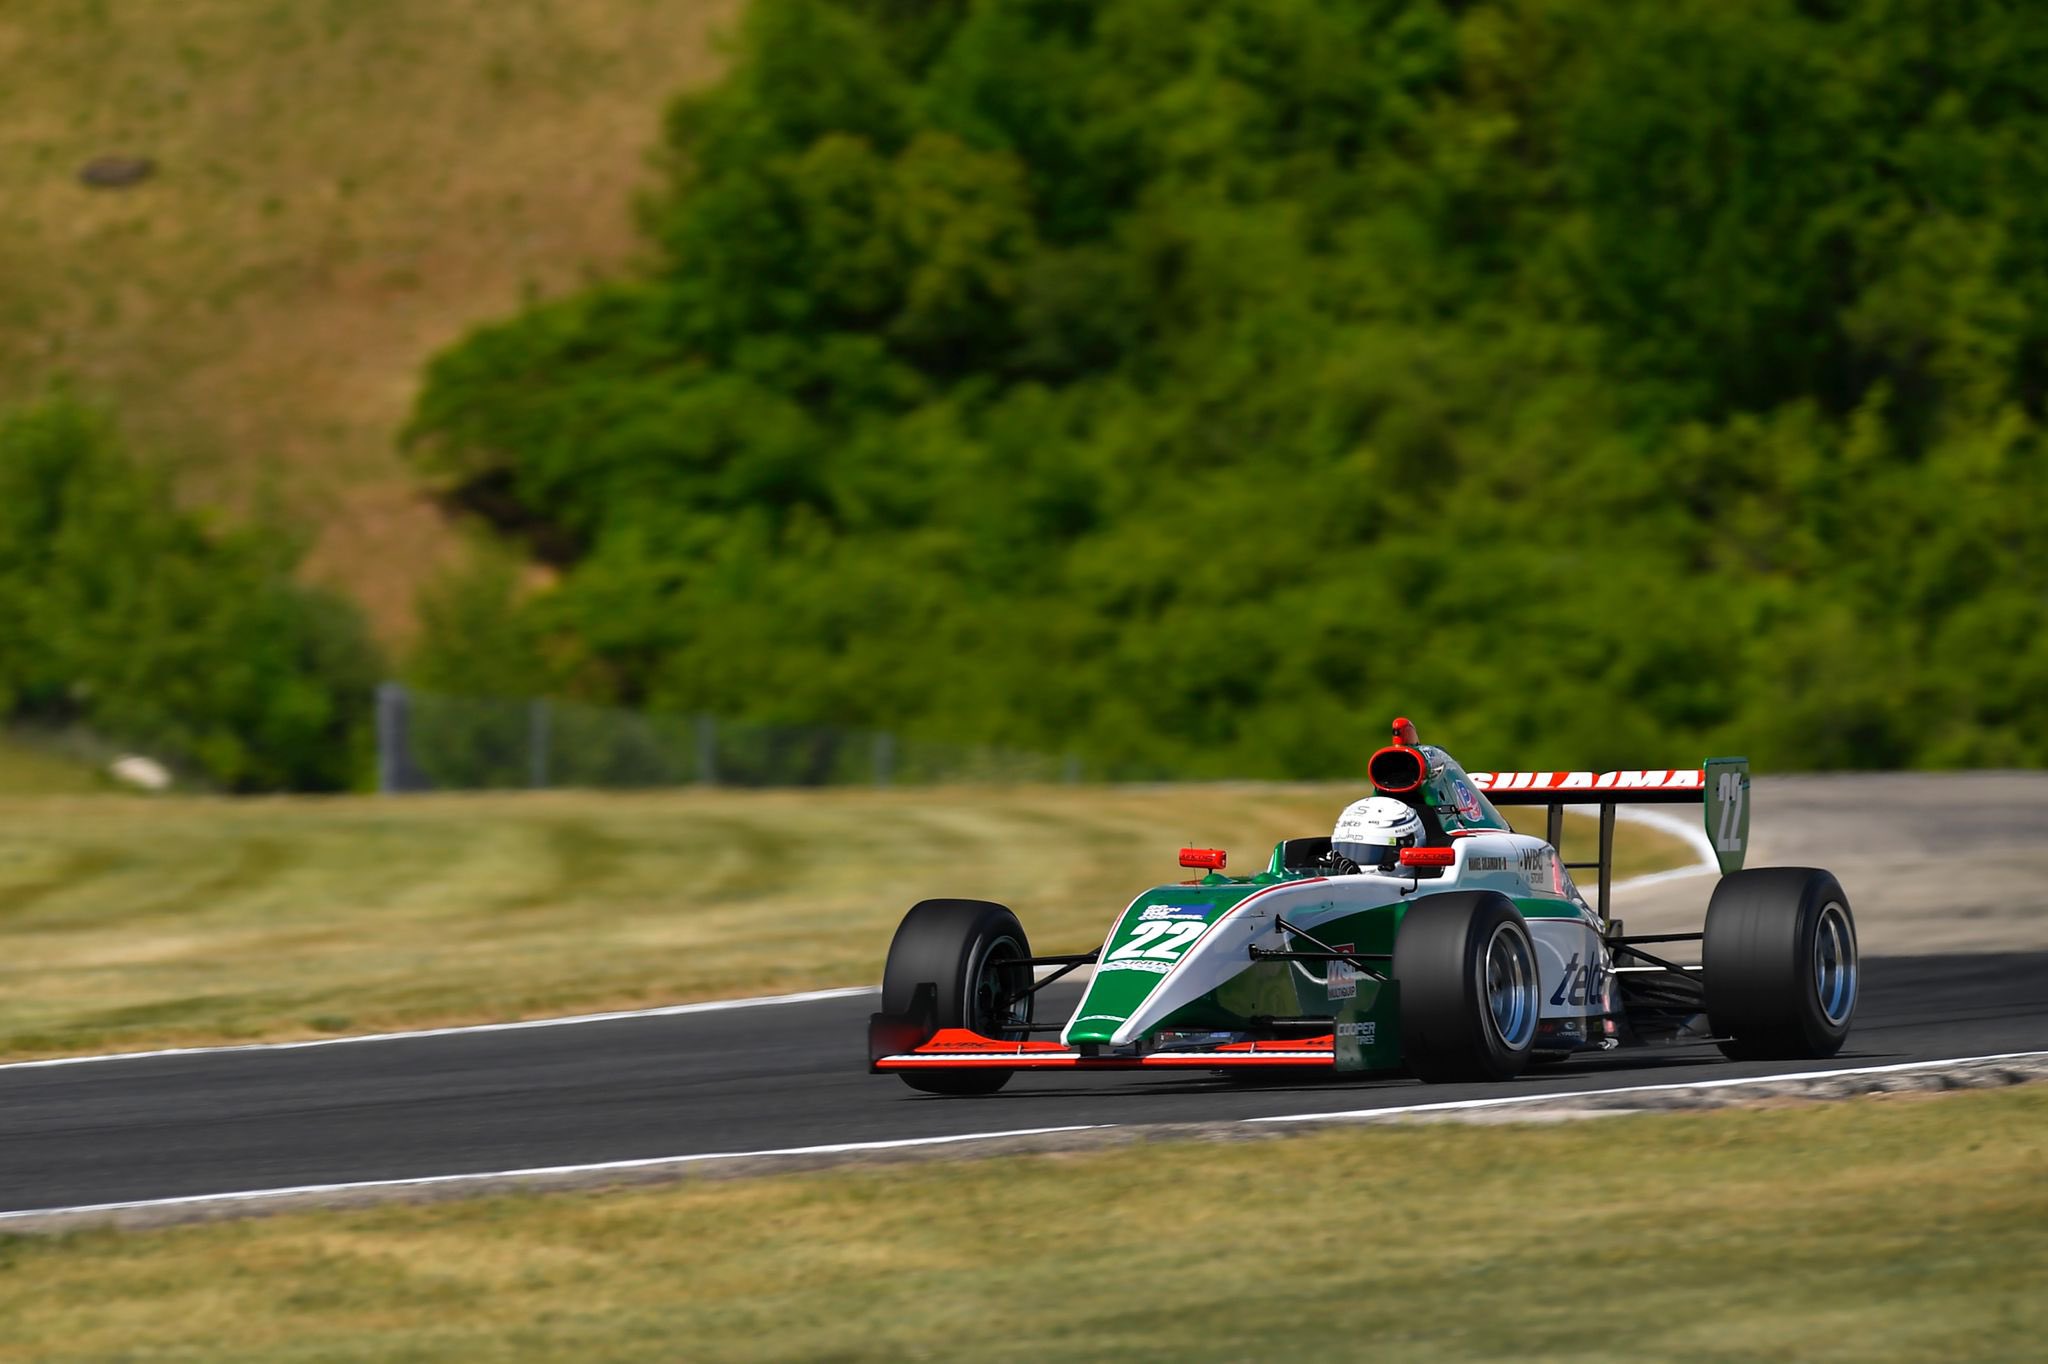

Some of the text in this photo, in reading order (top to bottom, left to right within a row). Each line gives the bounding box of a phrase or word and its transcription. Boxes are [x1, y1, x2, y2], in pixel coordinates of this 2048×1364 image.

[1717, 773, 1743, 852] 22
[1107, 920, 1208, 960] 22
[1337, 1021, 1376, 1036] COOPER
